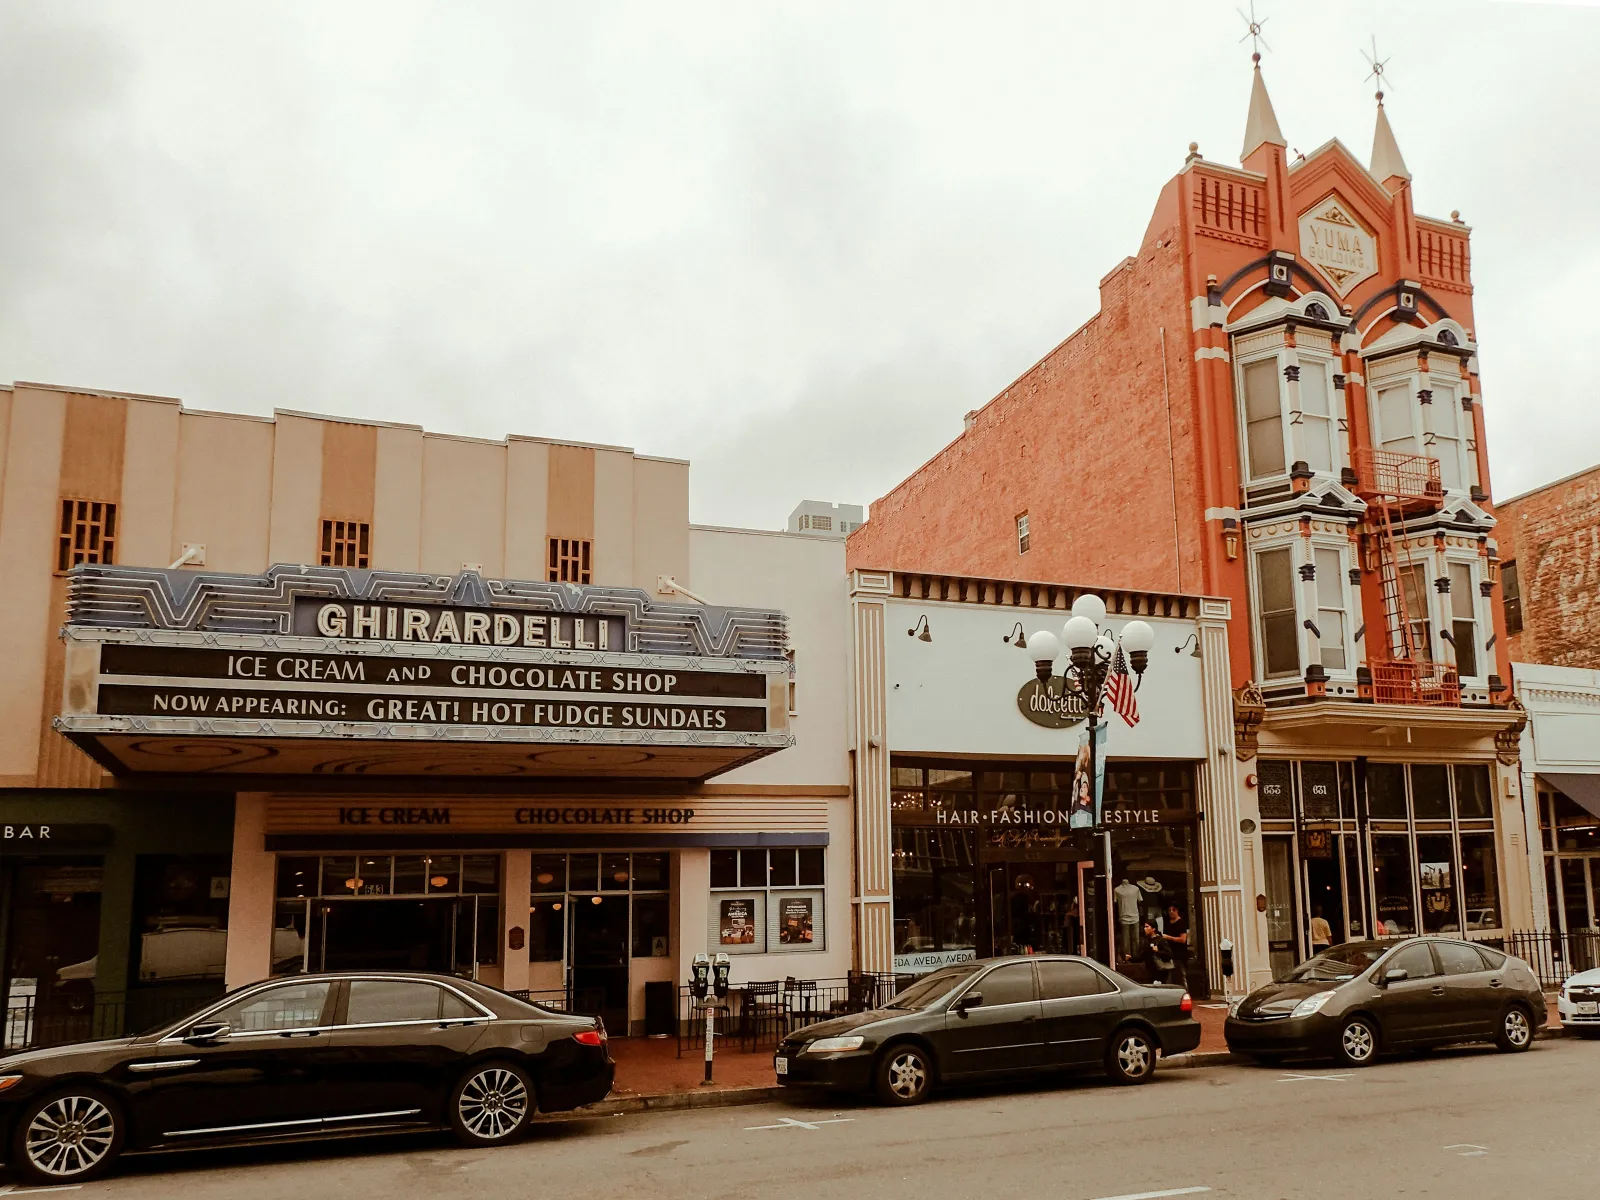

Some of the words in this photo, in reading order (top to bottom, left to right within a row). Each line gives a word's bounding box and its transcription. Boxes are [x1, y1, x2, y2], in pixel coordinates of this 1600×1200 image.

[1309, 225, 1363, 255] YUMA
[316, 602, 609, 651] GHIRARDELLI
[227, 655, 268, 678] ICE
[275, 657, 366, 682] CREAM
[385, 665, 432, 683] AND
[450, 664, 603, 692] CHOCOLATE
[611, 671, 678, 694] SHOP
[153, 693, 210, 713] NOW
[215, 695, 347, 716] APPEARING:
[366, 698, 460, 722] GREAT!
[471, 701, 526, 724] HOT
[533, 703, 614, 727] FUDGE
[620, 706, 727, 730] SUNDAES
[1263, 784, 1282, 795] 633
[1312, 784, 1327, 795] 631
[338, 807, 372, 825] ICE
[378, 807, 450, 825] CREAM
[514, 807, 635, 825] CHOCOLATE
[641, 807, 696, 825] SHOP
[936, 810, 980, 824] HAIR
[991, 810, 1069, 824] FASHION
[1104, 809, 1160, 823] ESTYLE
[3, 825, 52, 840] BAR
[894, 958, 911, 967] EDA
[913, 955, 943, 967] AVEDA
[945, 953, 973, 964] AVEDA
